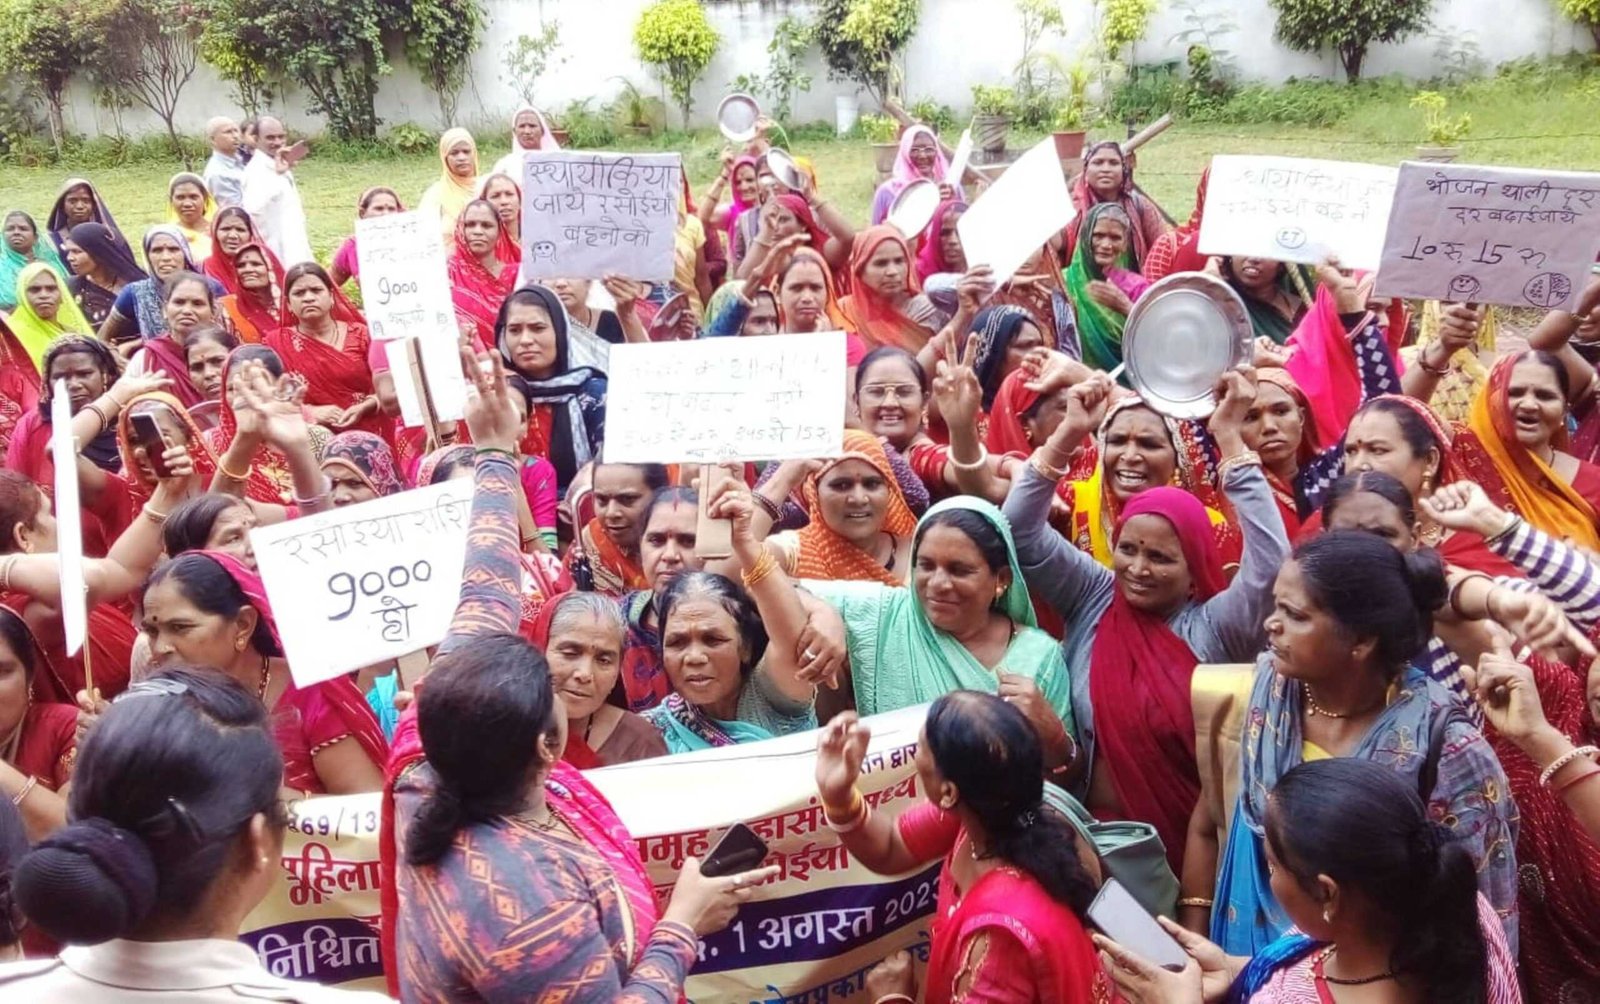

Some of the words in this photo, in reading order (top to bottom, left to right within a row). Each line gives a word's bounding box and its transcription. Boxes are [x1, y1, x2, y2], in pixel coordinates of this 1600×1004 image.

[1426, 171, 1498, 197] भोजन
[327, 560, 432, 621] 9000
[371, 596, 418, 642] हो
[887, 742, 918, 769] द्वार
[733, 920, 746, 953] 1
[757, 905, 875, 950] अगस्त
